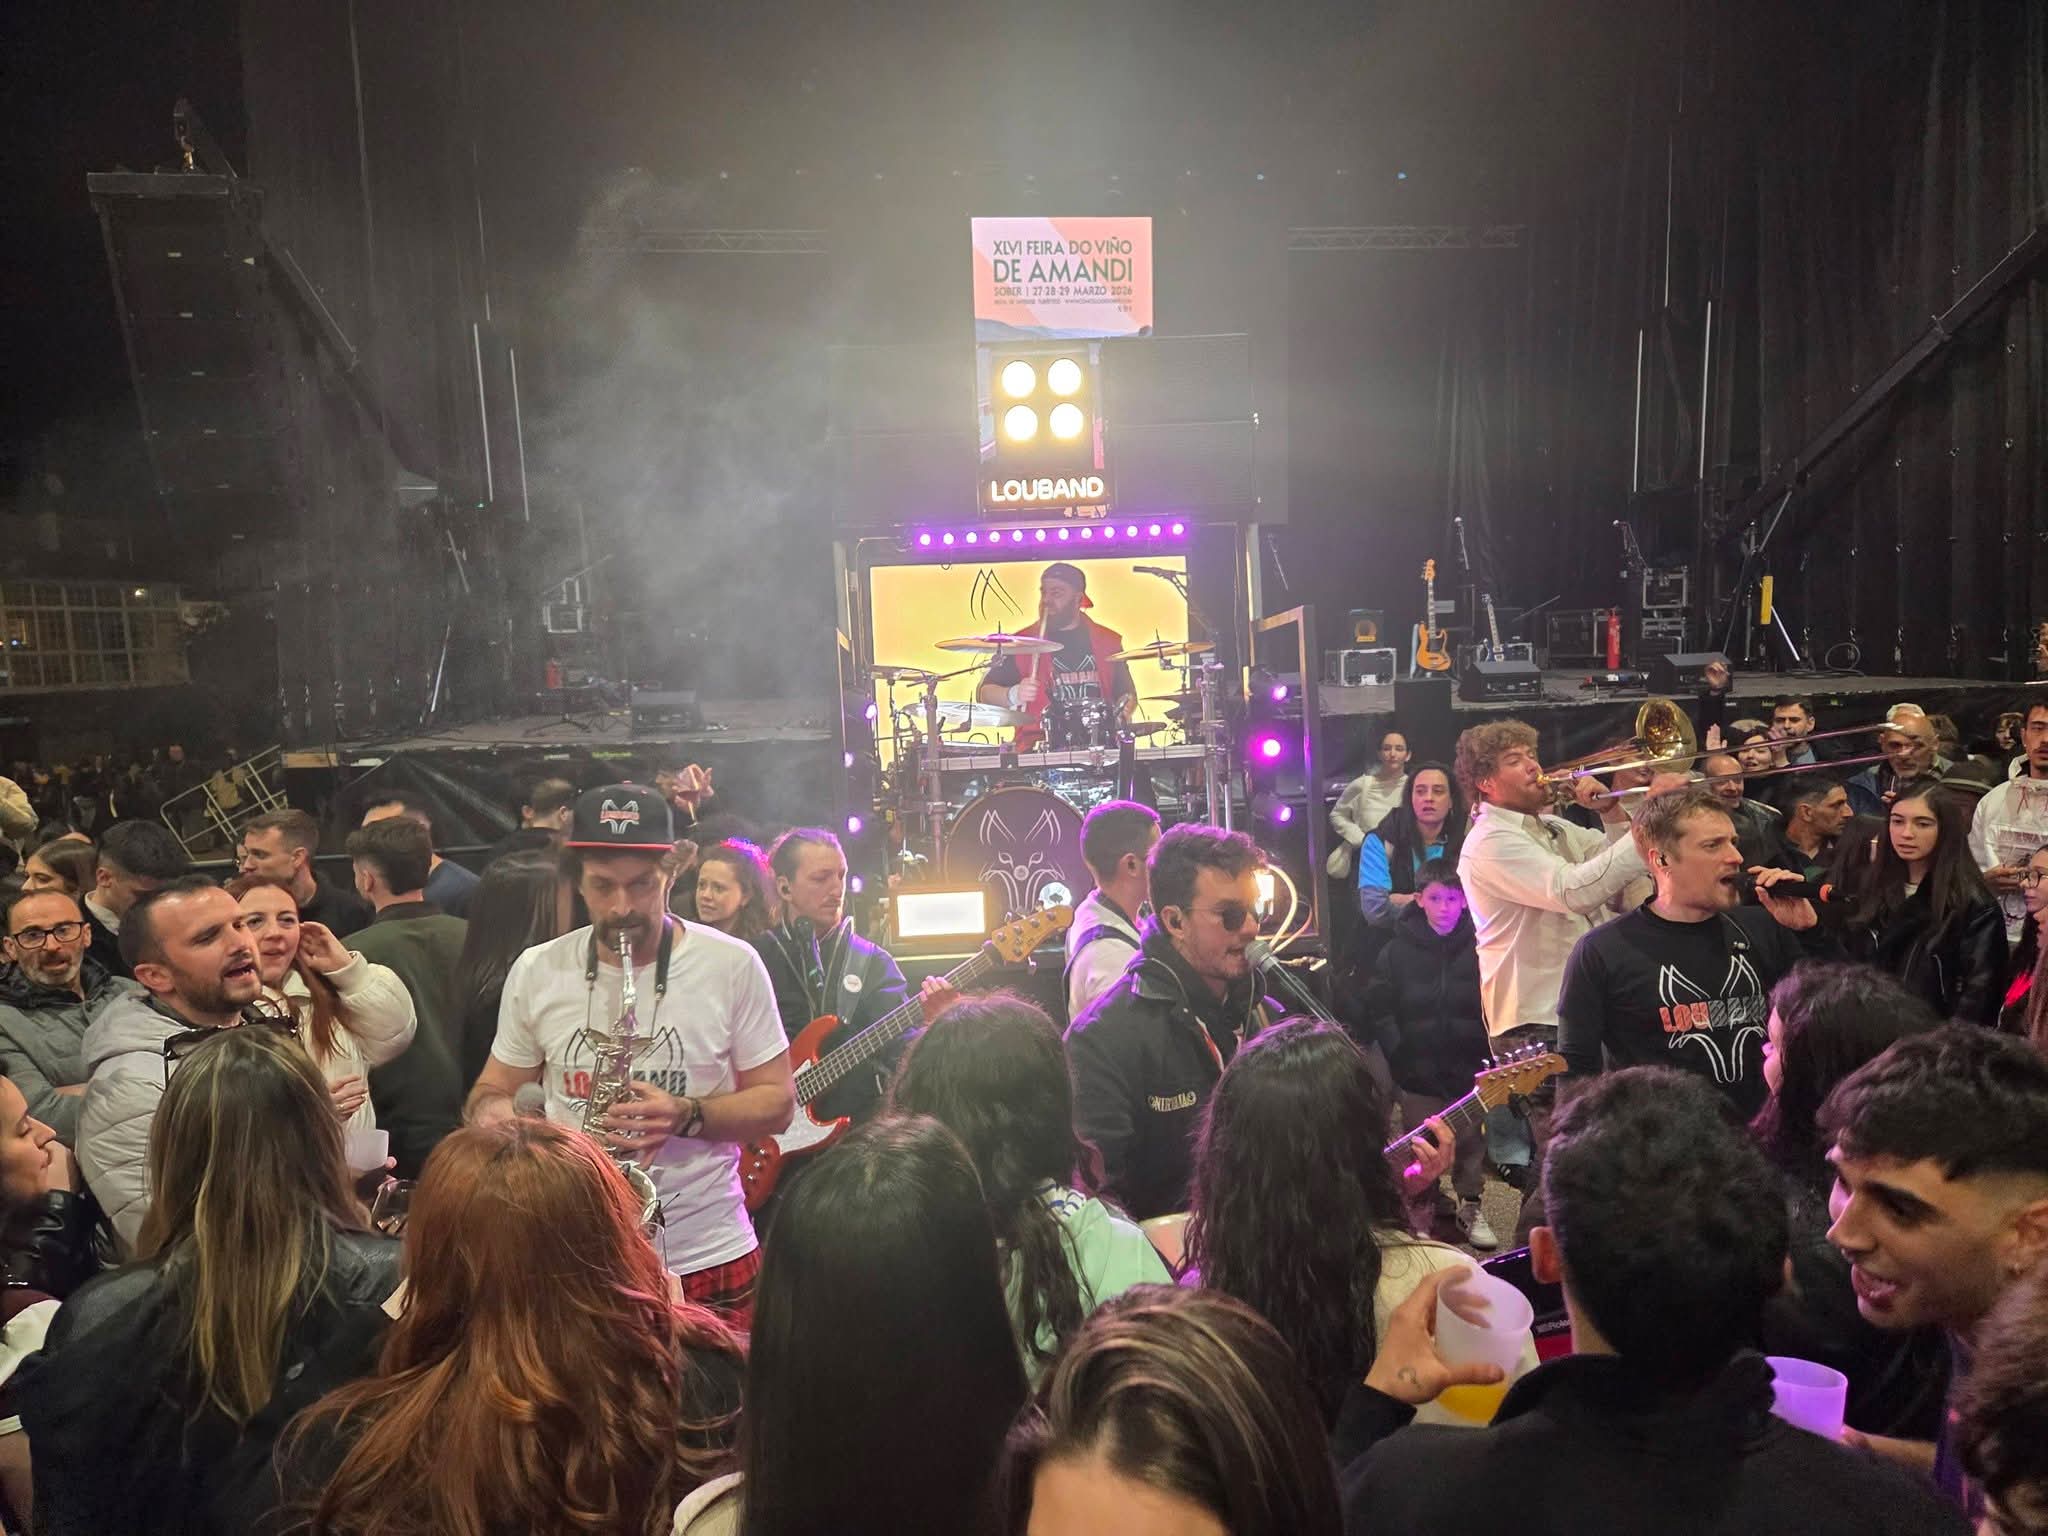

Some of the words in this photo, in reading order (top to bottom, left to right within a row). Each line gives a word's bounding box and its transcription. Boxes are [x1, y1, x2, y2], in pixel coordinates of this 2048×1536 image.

[993, 240, 1022, 255] XLVI
[1027, 240, 1065, 255] FEIRA
[1069, 240, 1092, 255] DO
[1094, 236, 1132, 255] VIÑO
[993, 259, 1021, 283] DE
[1028, 258, 1133, 283] AMANDI
[994, 287, 1022, 297] SOBER
[1073, 286, 1107, 297] MARZO
[991, 476, 1104, 502] LOUBAND
